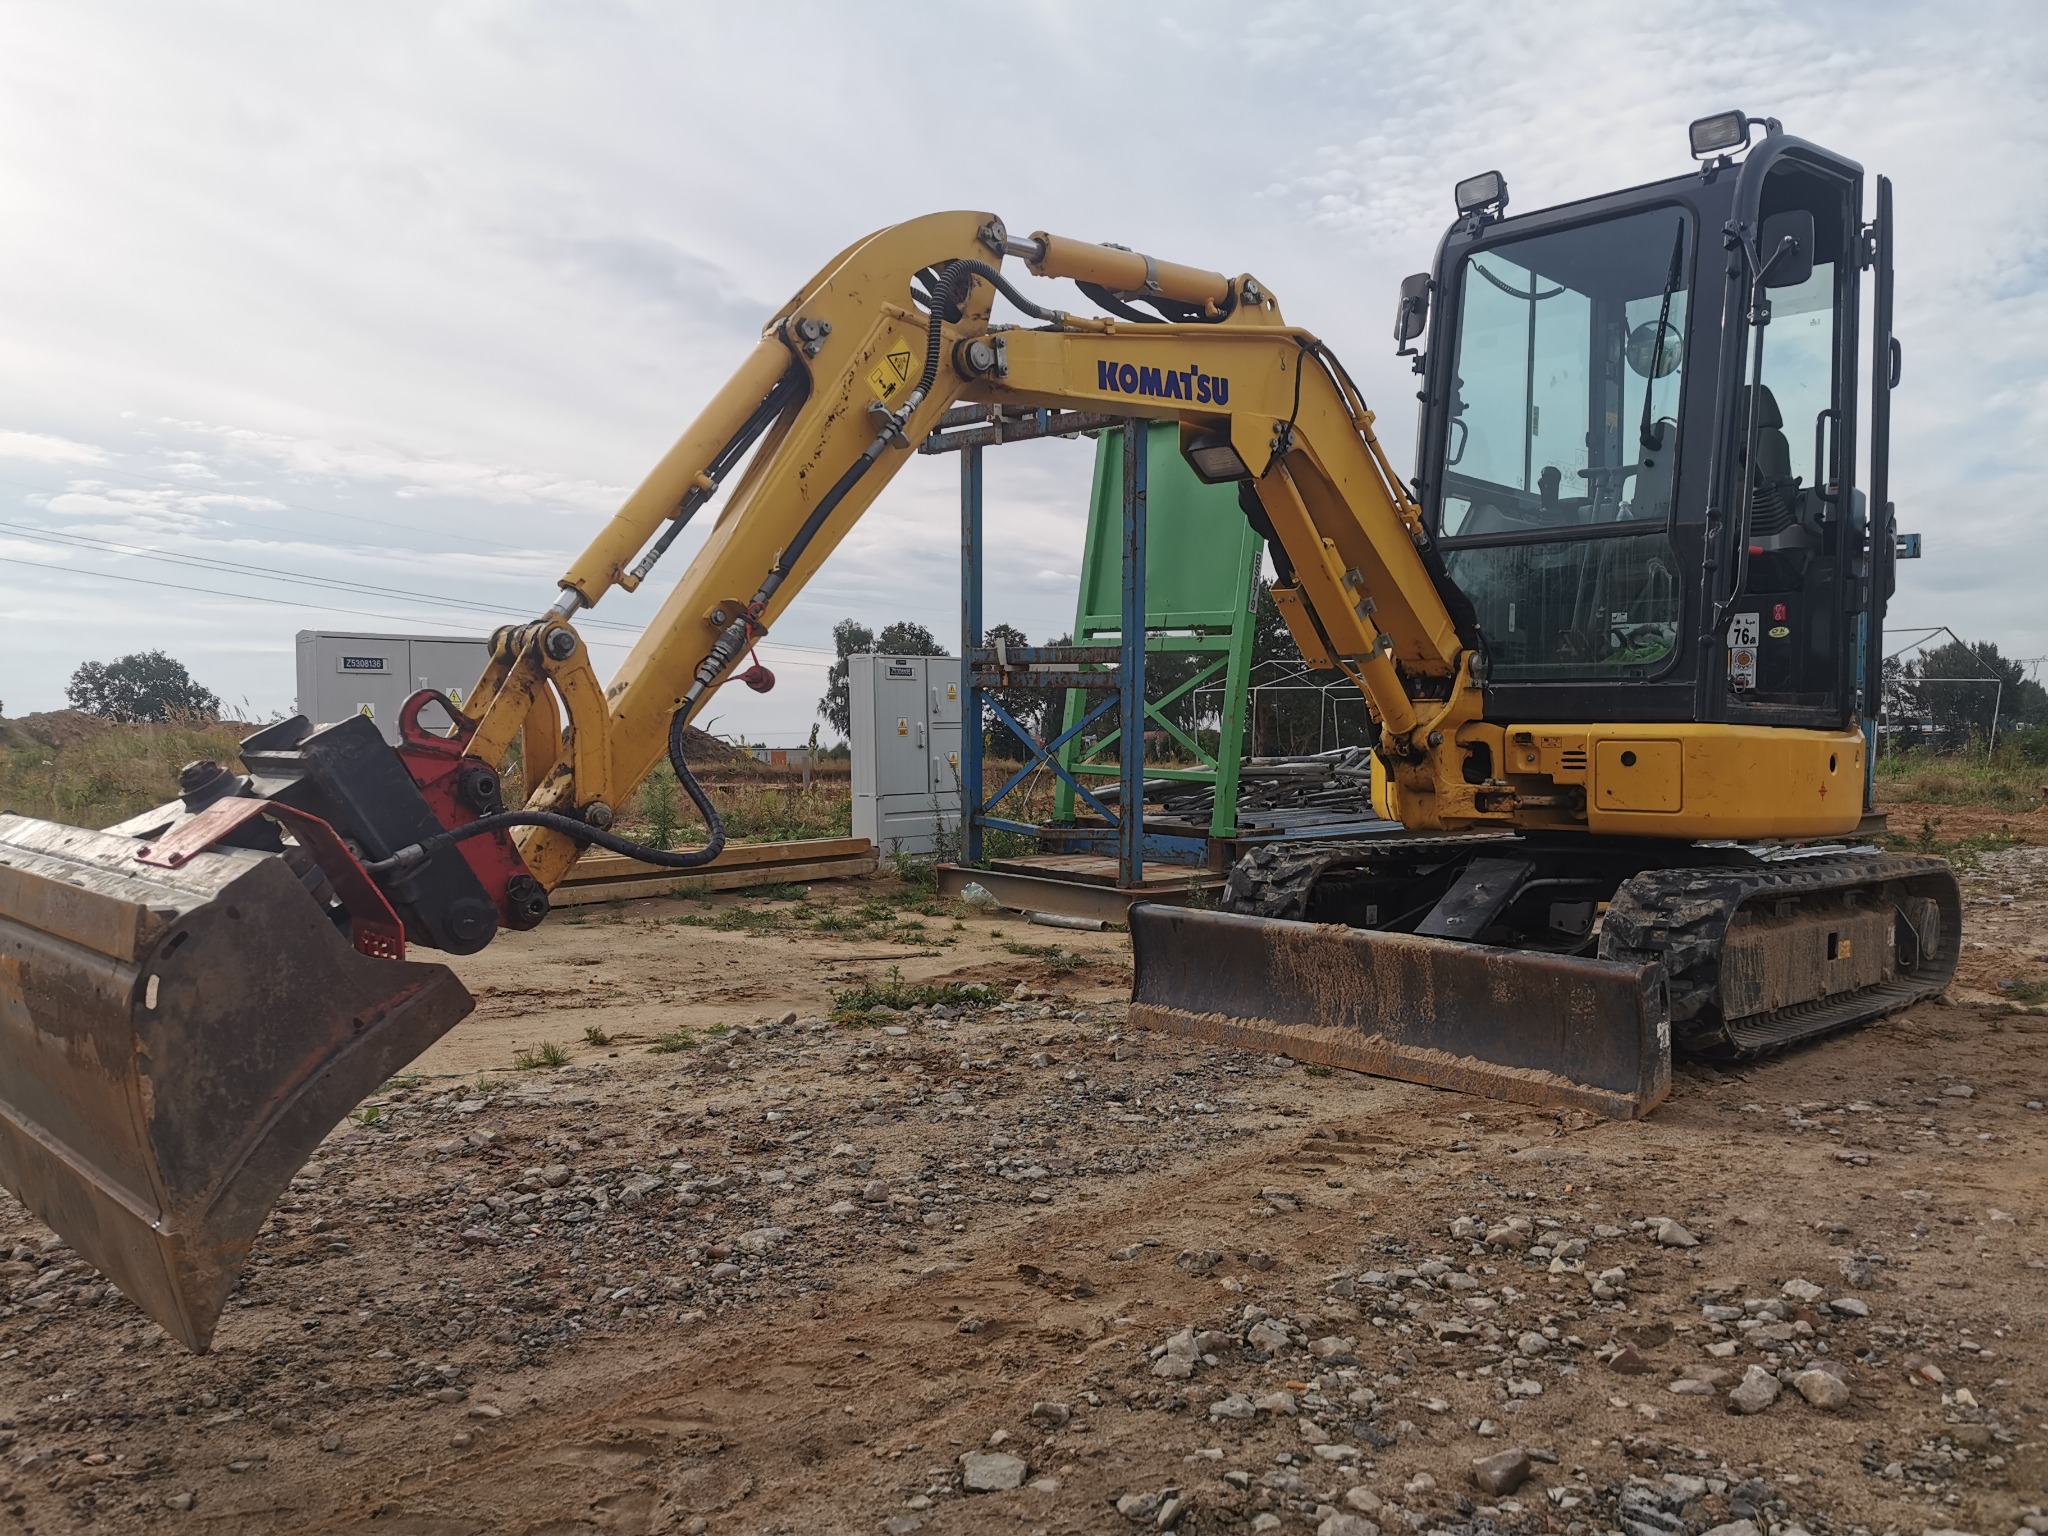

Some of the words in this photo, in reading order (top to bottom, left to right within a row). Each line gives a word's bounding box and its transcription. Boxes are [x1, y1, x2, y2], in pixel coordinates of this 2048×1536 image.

[1098, 360, 1229, 406] KOMATSU
[1733, 628, 1750, 645] 76
[346, 659, 382, 668] Z5308136
